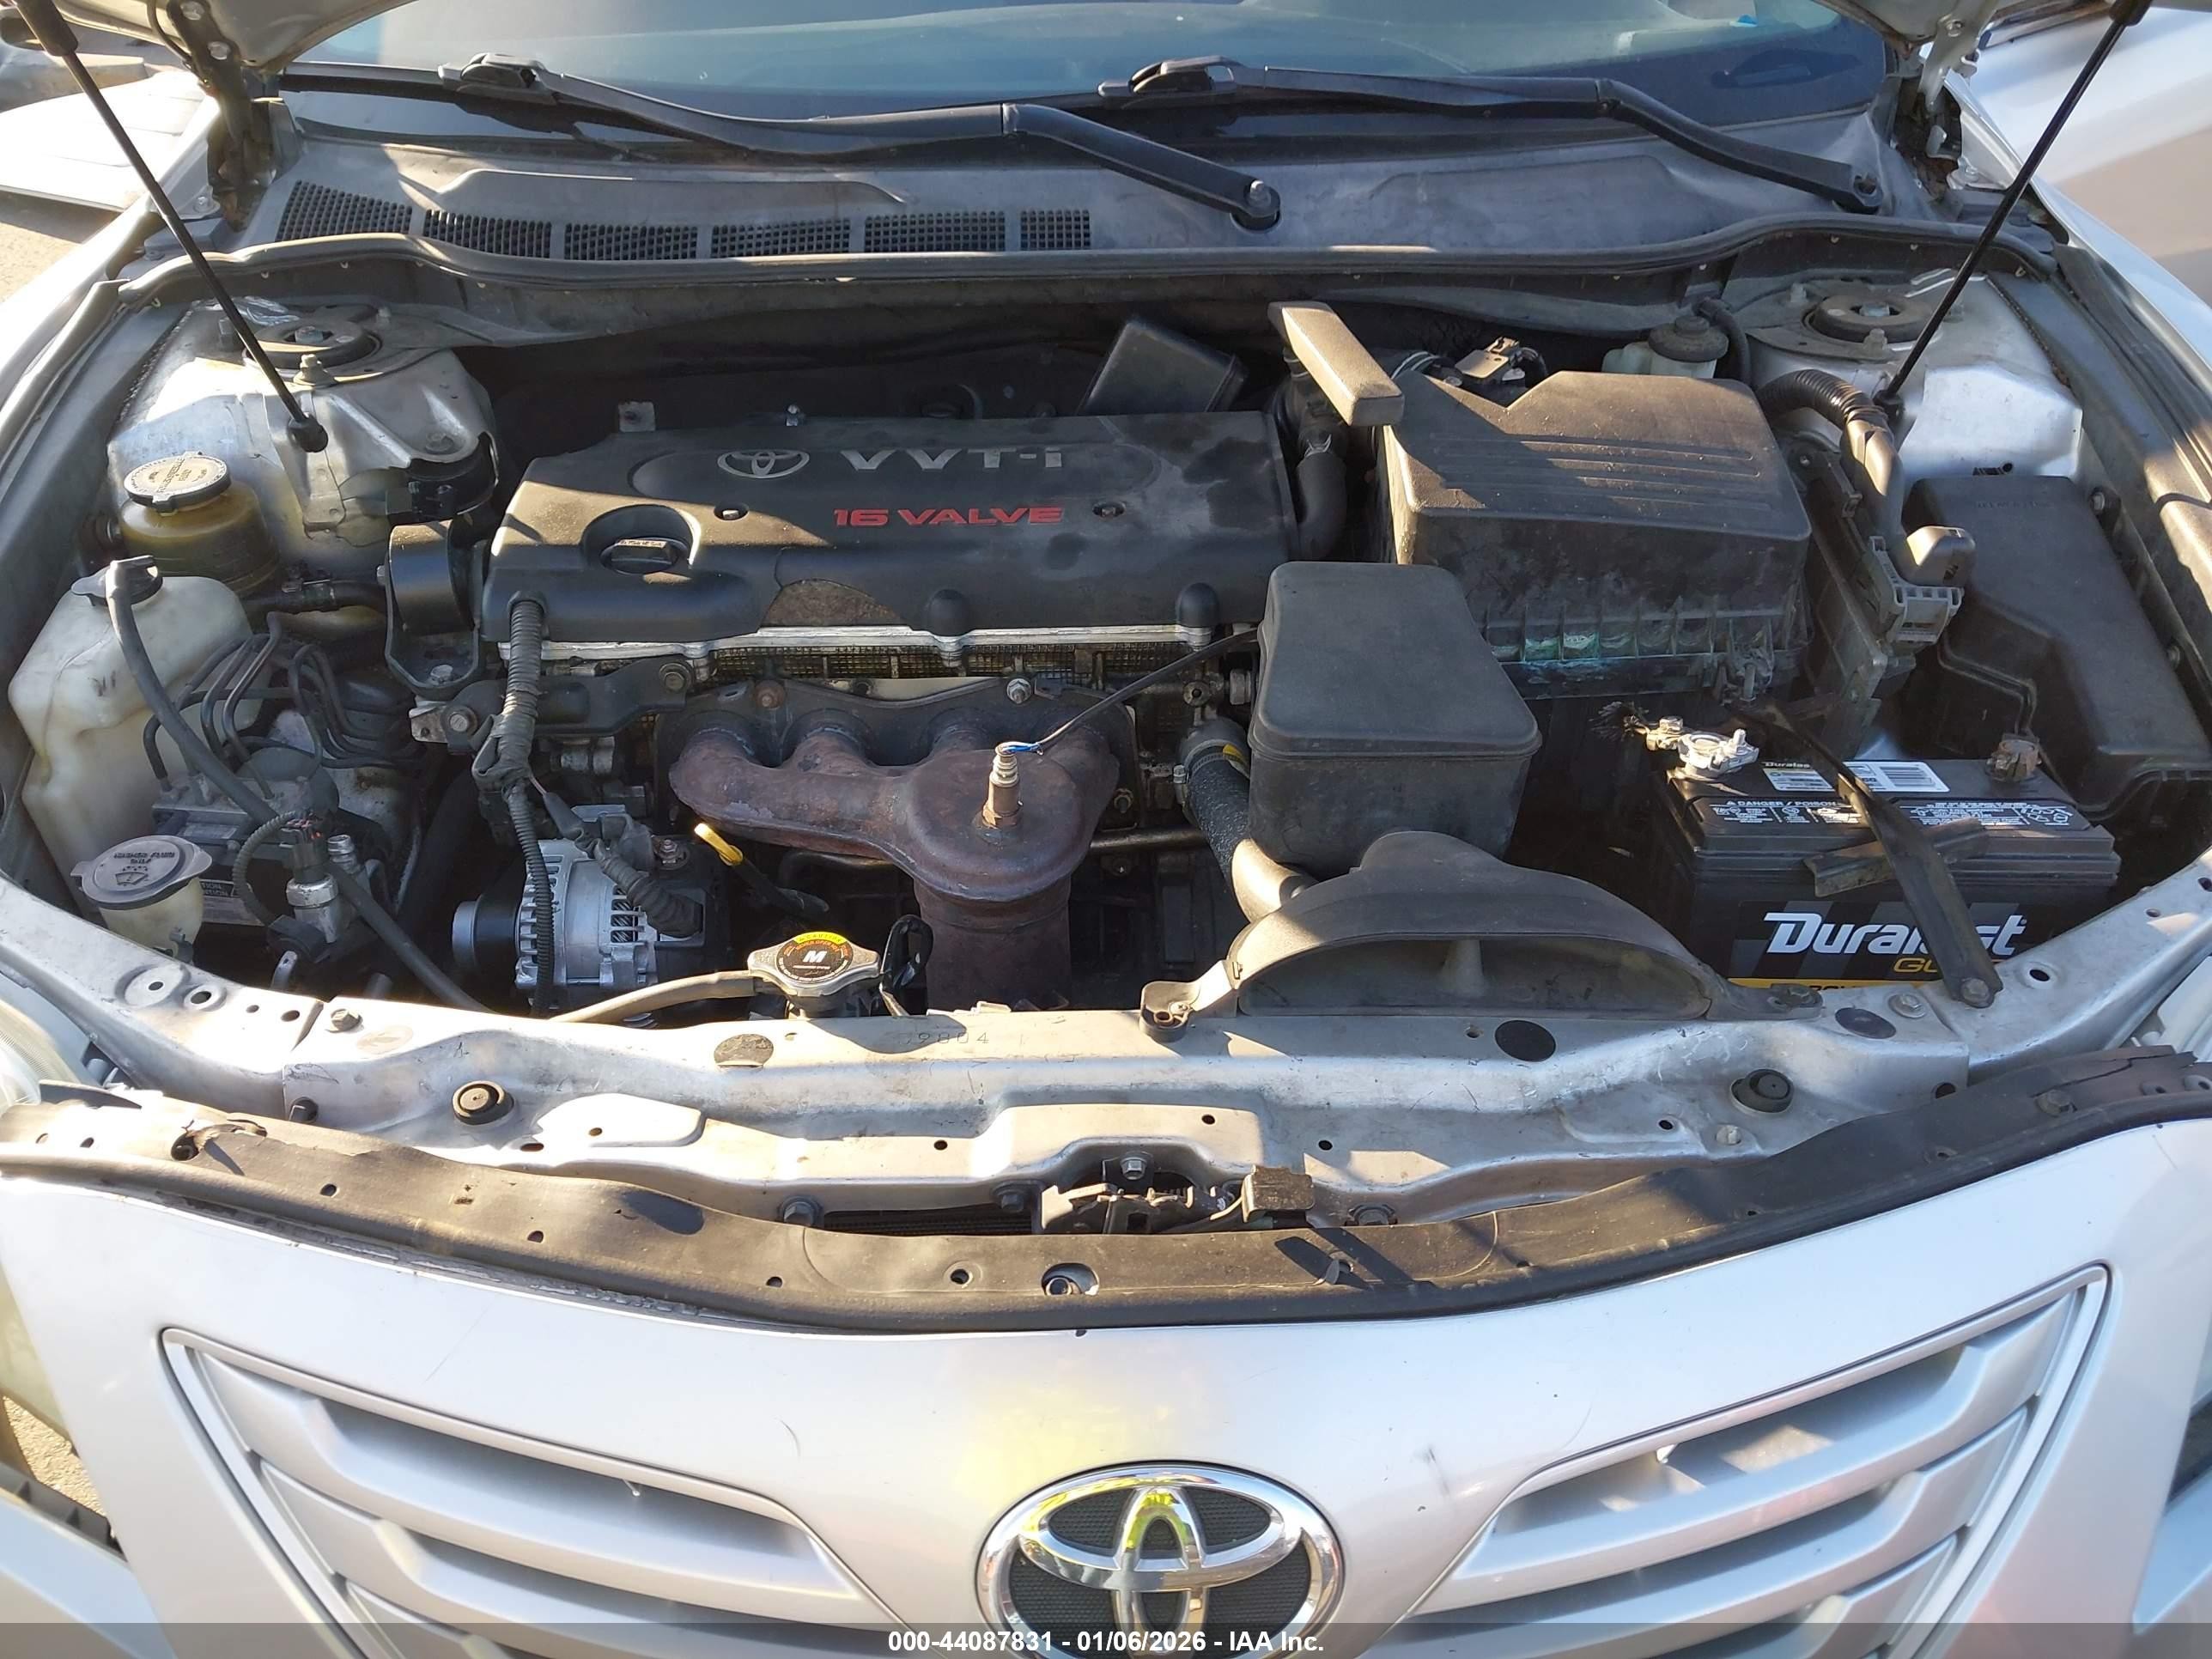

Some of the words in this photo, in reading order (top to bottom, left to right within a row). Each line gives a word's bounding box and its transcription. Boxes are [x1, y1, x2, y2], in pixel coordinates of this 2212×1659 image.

[841, 447, 1062, 471] VVT-i
[834, 508, 889, 526] 16
[897, 506, 1064, 526] VALVE
